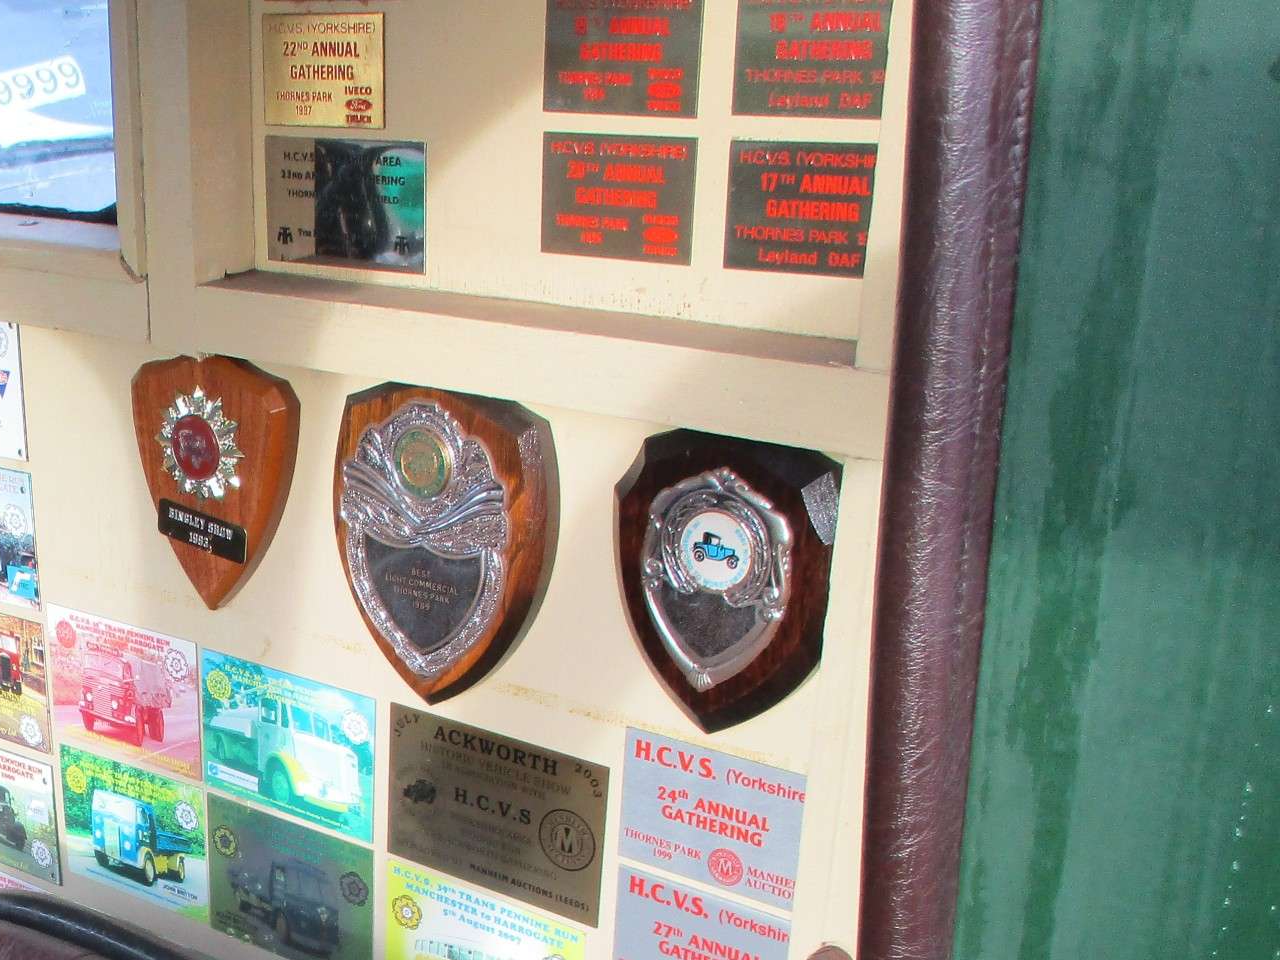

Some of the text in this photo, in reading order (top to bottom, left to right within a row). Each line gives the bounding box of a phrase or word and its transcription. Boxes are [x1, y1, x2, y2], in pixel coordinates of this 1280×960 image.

[283, 41, 359, 58] 22ND ANNUAL
[290, 65, 353, 80] GATHERING
[277, 91, 332, 101] THORNES PARK
[345, 86, 372, 95] IVECO
[375, 157, 401, 166] AREA
[761, 172, 870, 196] 17TH ANNUAL
[766, 199, 860, 222] GATHERING
[735, 225, 848, 244] THORNES PARK
[758, 248, 860, 267] Leyland DAF
[169, 507, 233, 540] BINGLEY SHOW
[409, 580, 457, 595] COMMERCIAL
[433, 726, 559, 776] ACKWORTH
[635, 738, 716, 780] H.C.V.S.
[28, 763, 43, 774] RUN
[454, 786, 532, 825] H.C.V.S
[657, 786, 770, 832] 24th ANNUAL
[661, 805, 763, 848] GATHERING
[625, 827, 701, 860] THORNES PARK
[653, 848, 672, 861] 1999
[469, 863, 510, 882] MANHEIM
[510, 877, 554, 898] AUCTIONS
[393, 866, 433, 888] H.C.V.S.
[459, 891, 496, 911] TRANS
[500, 906, 551, 932] PENNINE
[554, 927, 579, 944] RUN
[629, 875, 709, 919] H.C.V.S.
[405, 882, 564, 949] MANCHESTER to HARROGATE
[459, 914, 495, 935] August
[652, 921, 684, 938] 27th
